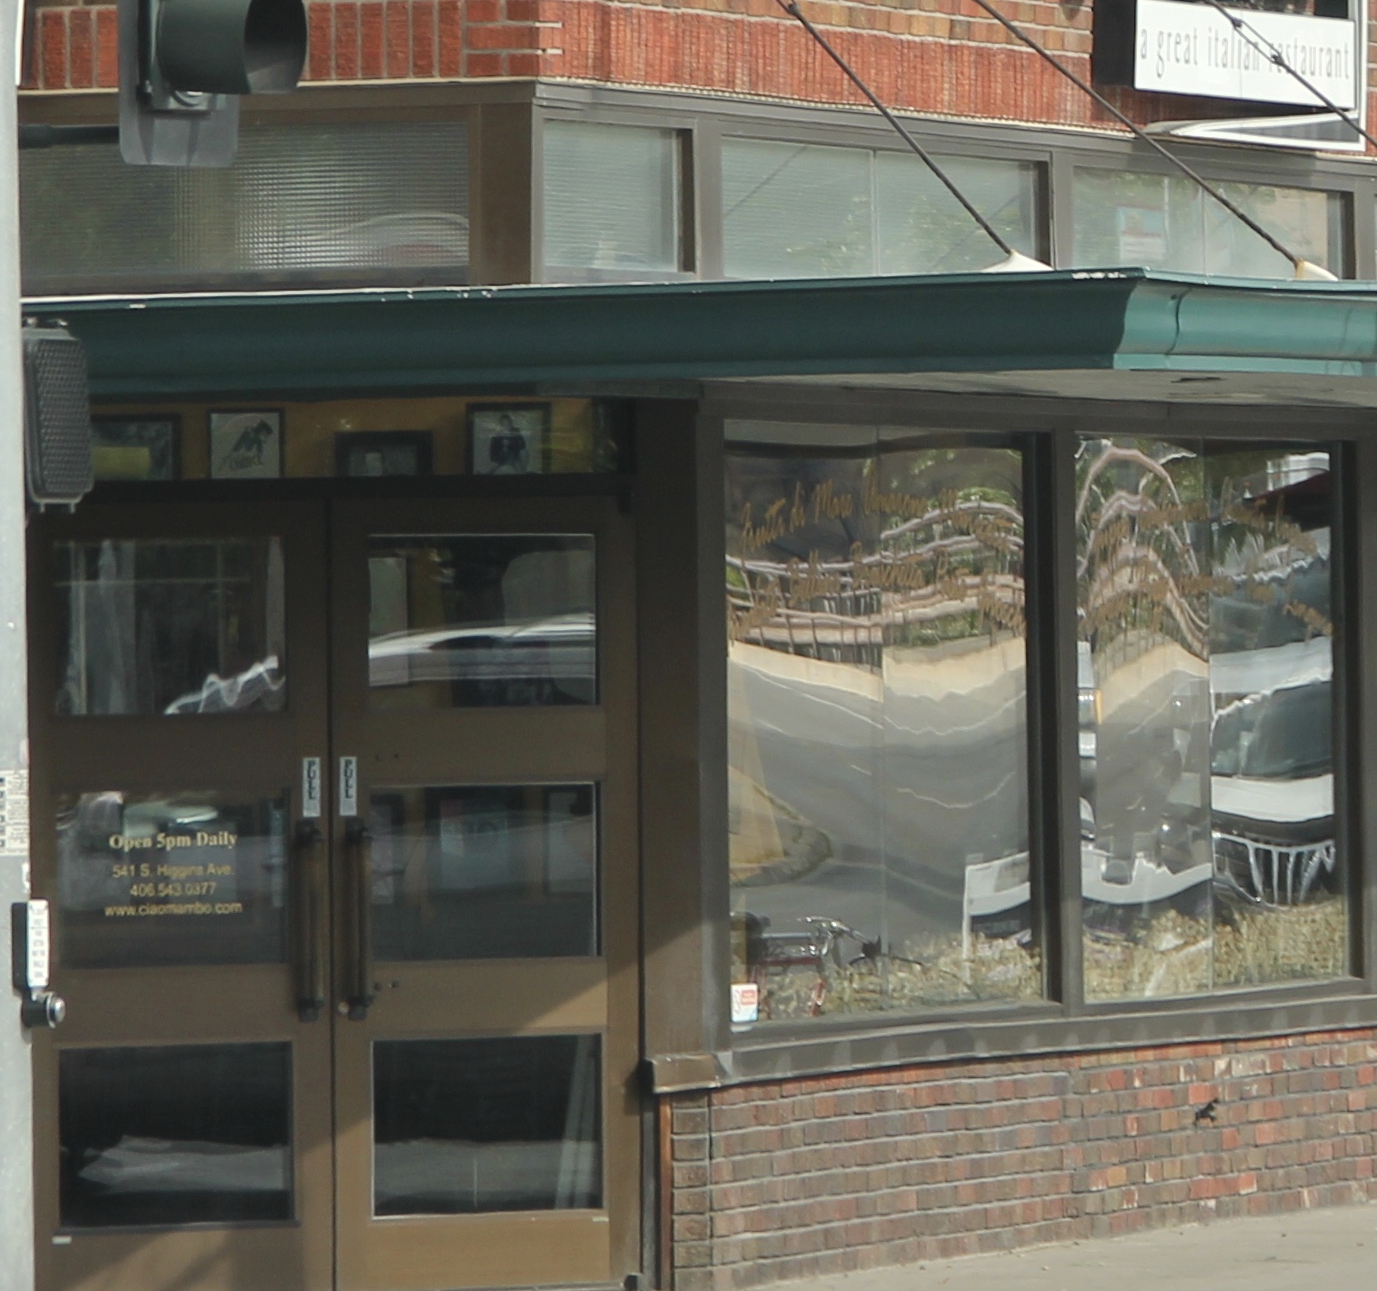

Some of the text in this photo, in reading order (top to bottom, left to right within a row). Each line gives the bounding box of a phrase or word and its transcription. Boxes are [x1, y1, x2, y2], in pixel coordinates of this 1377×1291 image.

[1140, 25, 1350, 81] a great italian restaurant
[306, 759, 318, 801] PULL
[344, 758, 354, 799] PULL
[108, 830, 238, 853] Open 5pm Daily
[112, 864, 136, 879] 541
[156, 863, 204, 880] Higgins
[104, 900, 244, 918] www.ciaomambo.com
